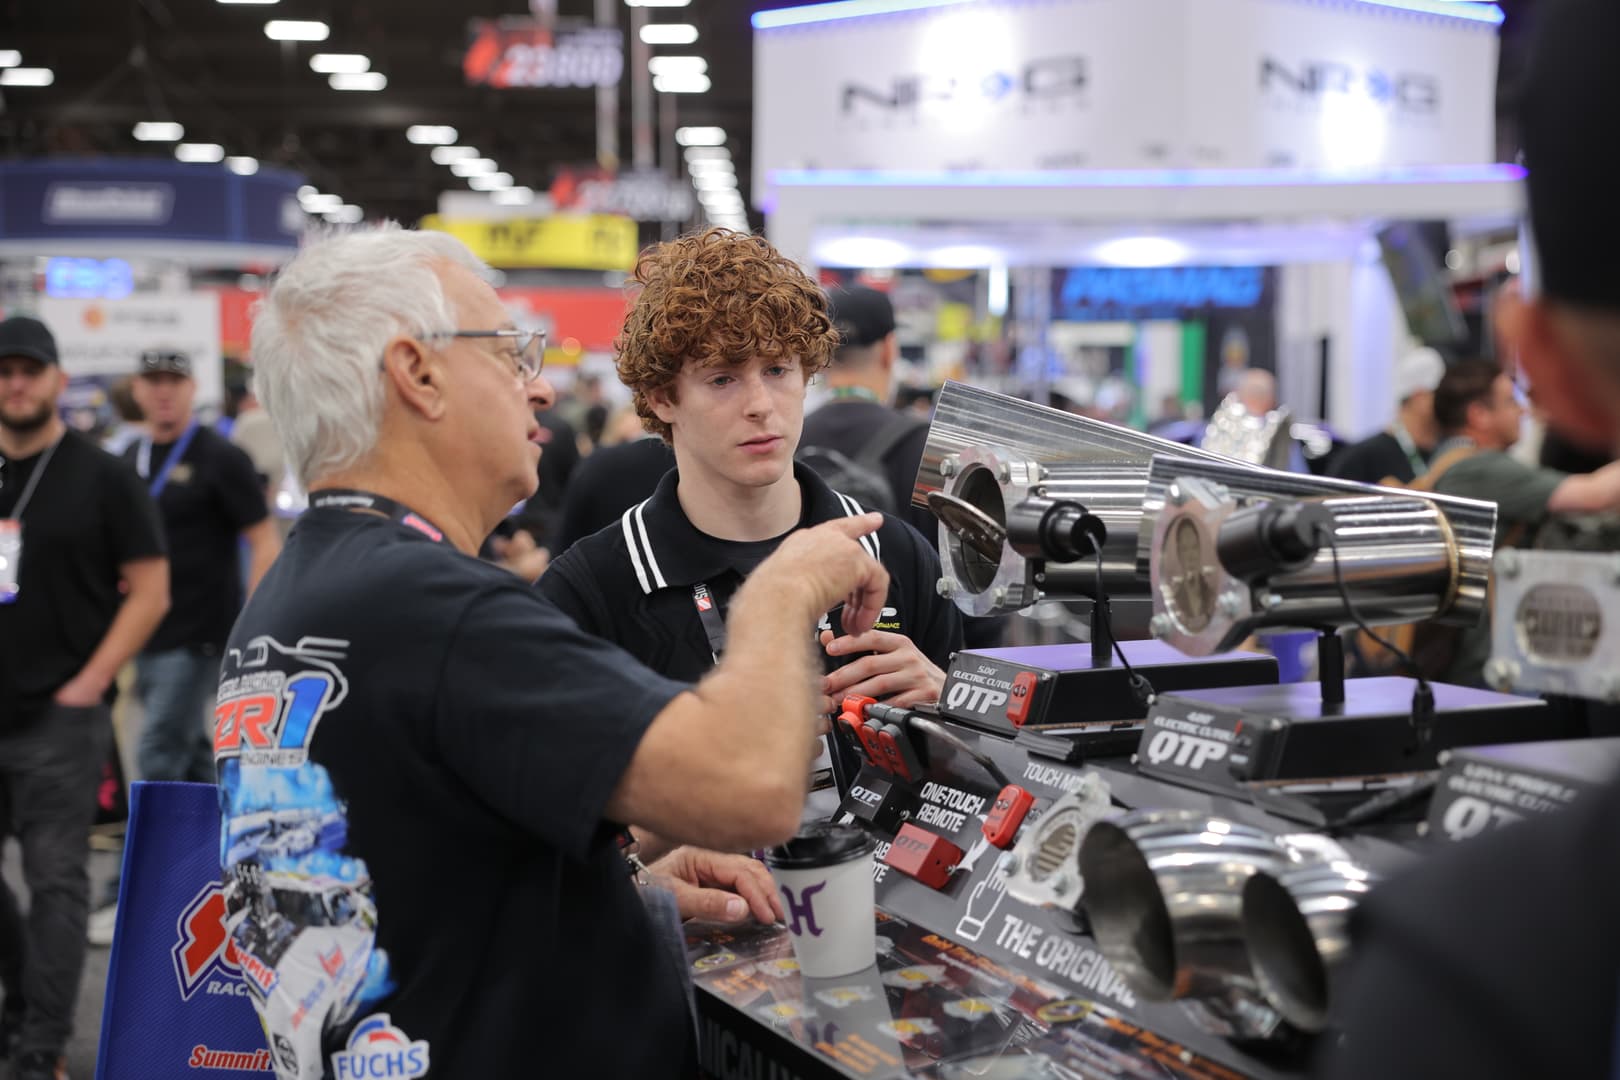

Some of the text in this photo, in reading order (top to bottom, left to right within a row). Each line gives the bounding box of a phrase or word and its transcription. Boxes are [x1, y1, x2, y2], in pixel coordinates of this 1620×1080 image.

[946, 681, 1008, 714] QTP
[986, 678, 1015, 691] CUTOU
[1147, 730, 1229, 770] QTP
[1022, 761, 1060, 789] TOUCH
[850, 785, 883, 803] QTP
[915, 802, 967, 833] REMOTE
[781, 880, 827, 937] H
[995, 913, 1044, 960] THE
[206, 981, 251, 996] RAC
[188, 1045, 270, 1071] Summit
[336, 1047, 424, 1080] FUCHS
